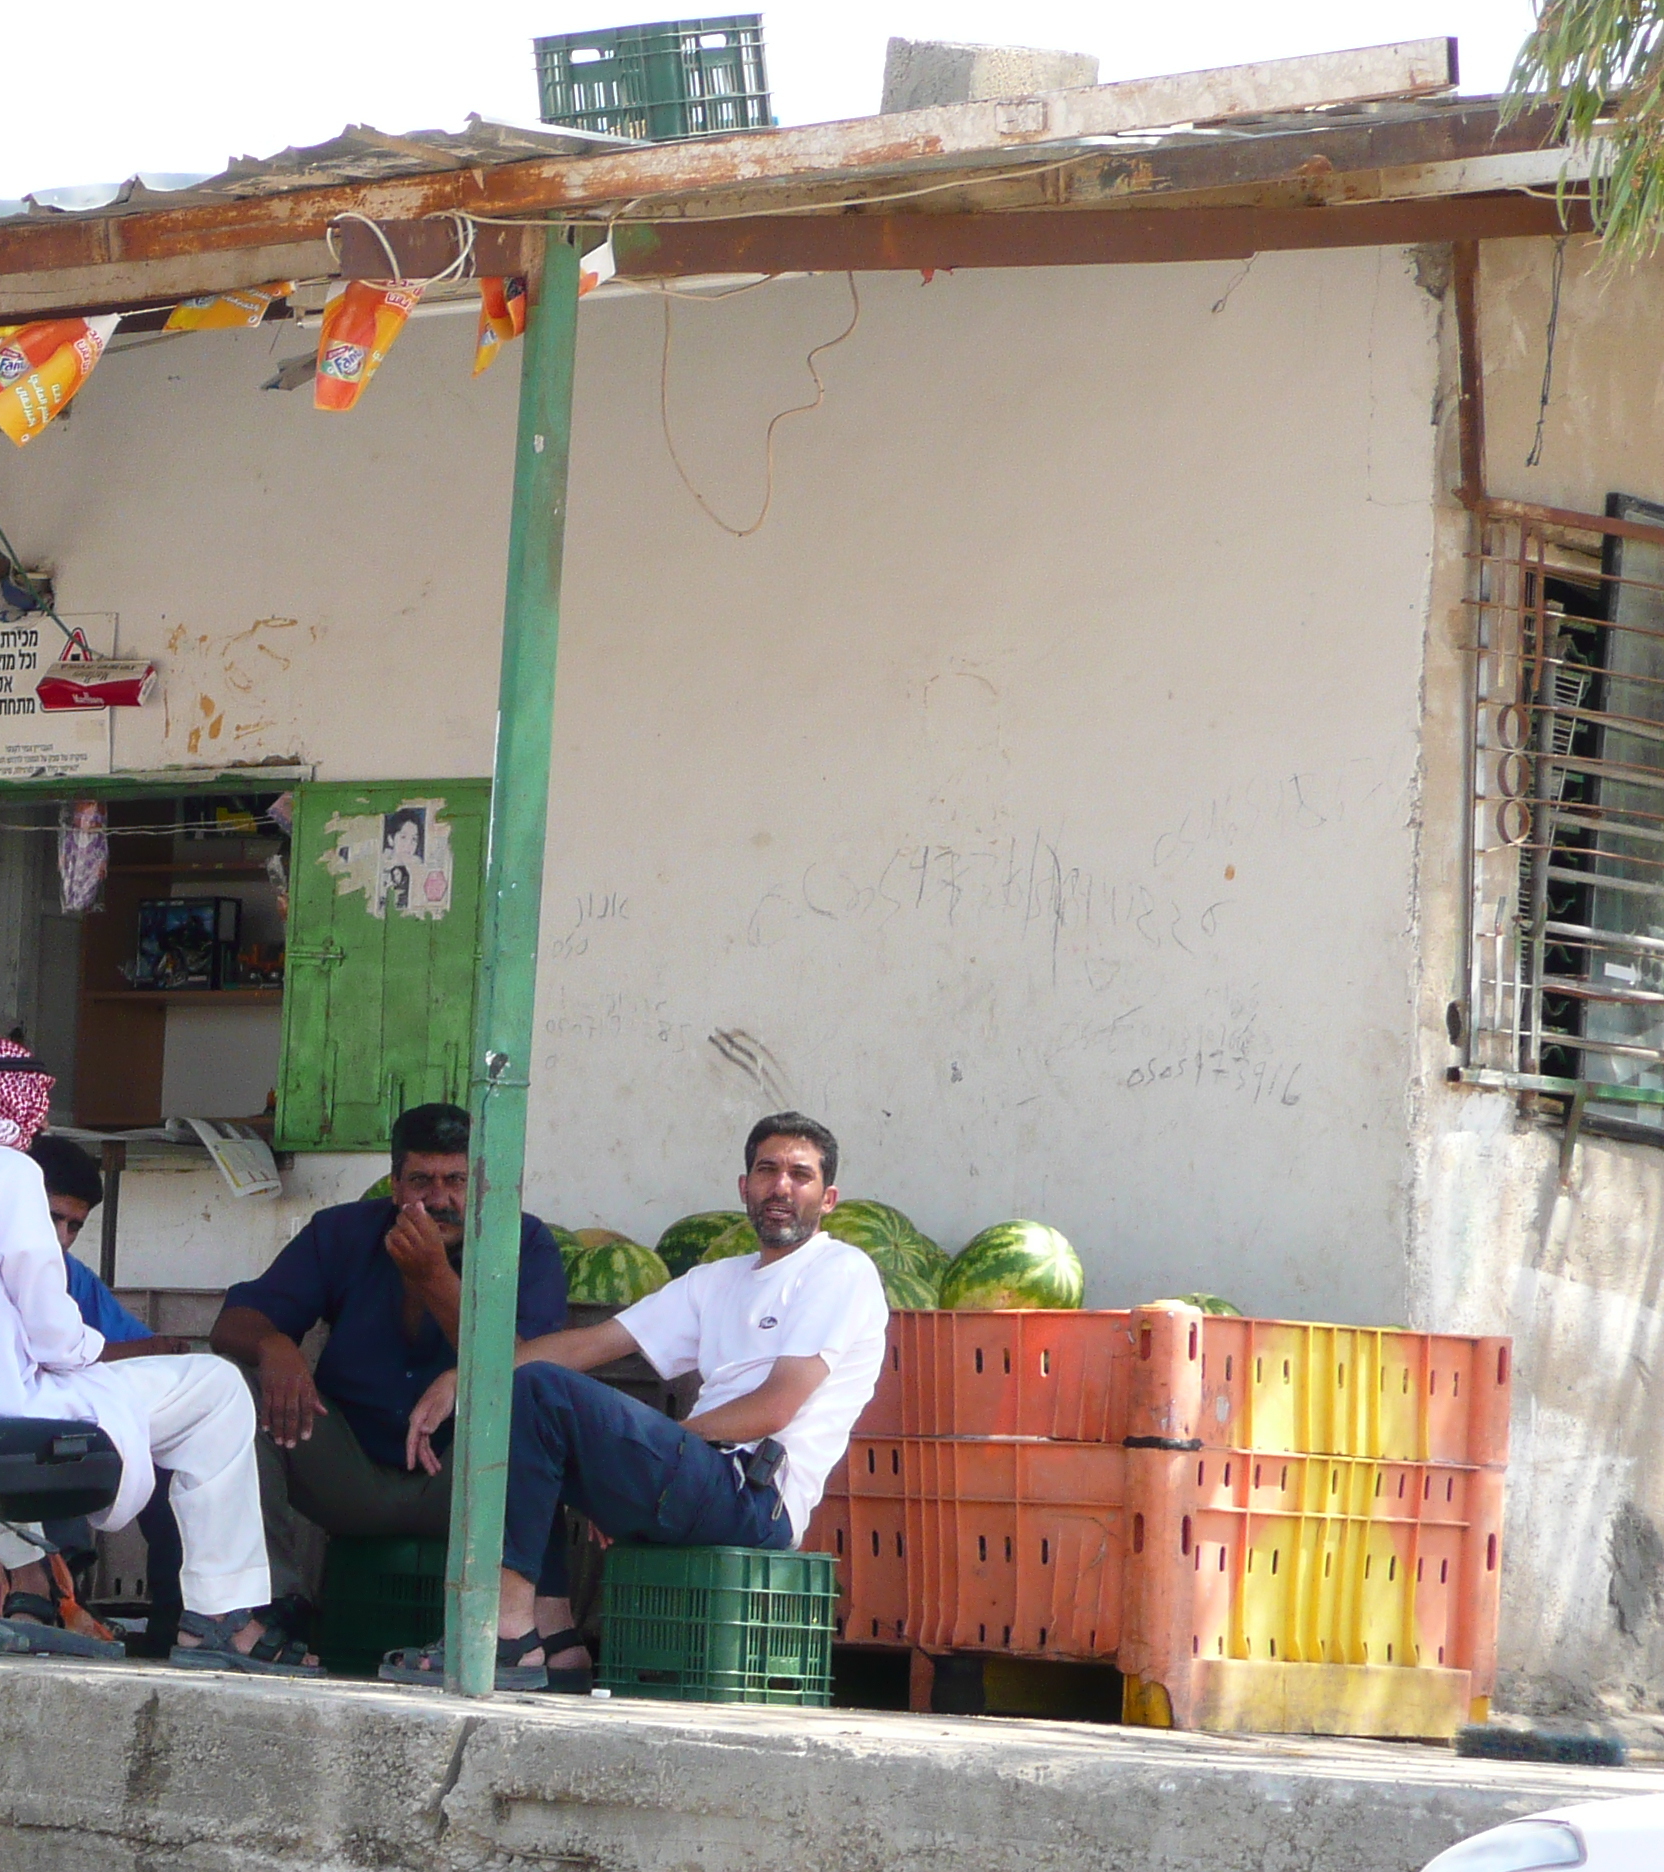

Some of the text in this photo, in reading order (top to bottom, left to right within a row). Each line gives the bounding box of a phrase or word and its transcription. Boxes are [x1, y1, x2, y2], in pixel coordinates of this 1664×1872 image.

[0, 629, 38, 648] מכירת
[19, 650, 37, 670] וכל
[0, 698, 35, 716] מתחת
